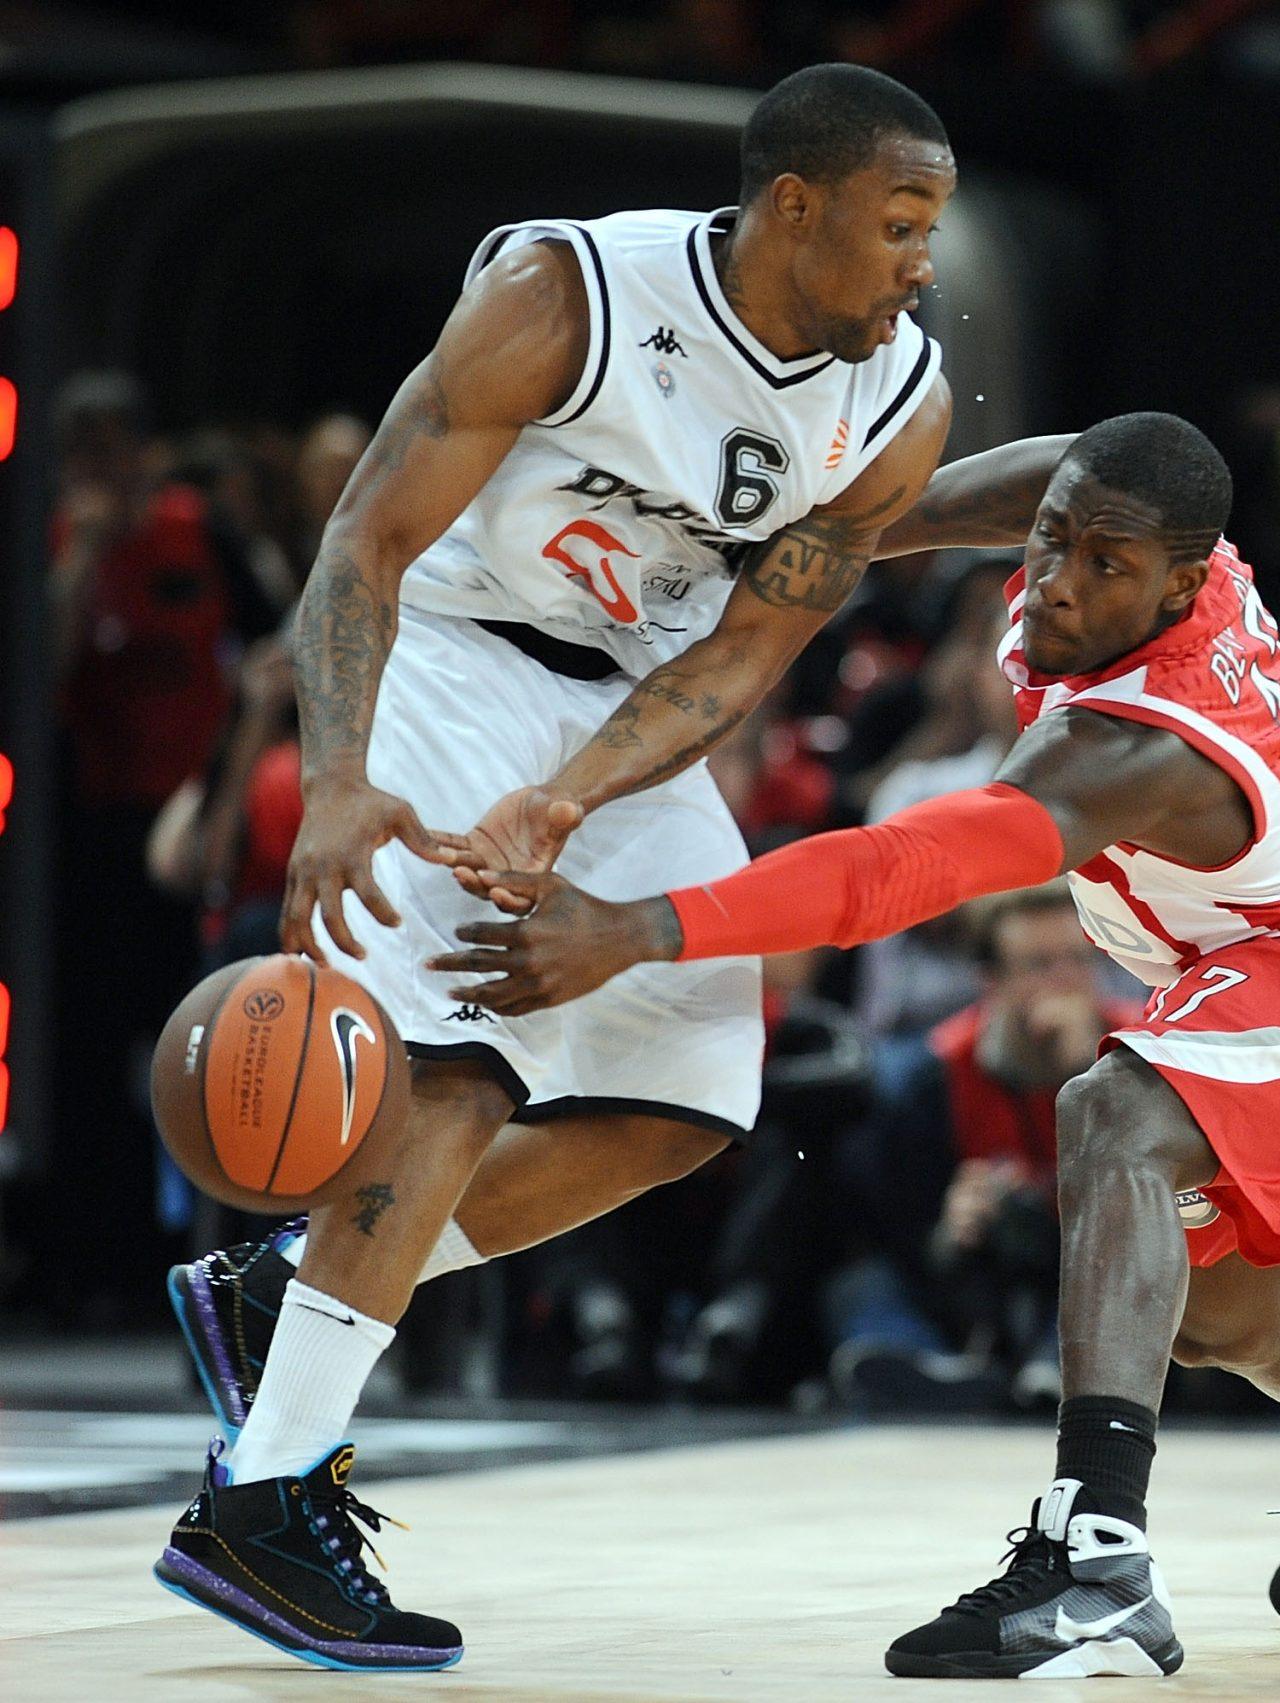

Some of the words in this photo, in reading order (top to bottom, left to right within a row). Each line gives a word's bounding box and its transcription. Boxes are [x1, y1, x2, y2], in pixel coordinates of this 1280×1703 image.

[714, 427, 790, 529] 6
[1146, 965, 1250, 1023] 17
[239, 1024, 260, 1126] BASKETBALL
